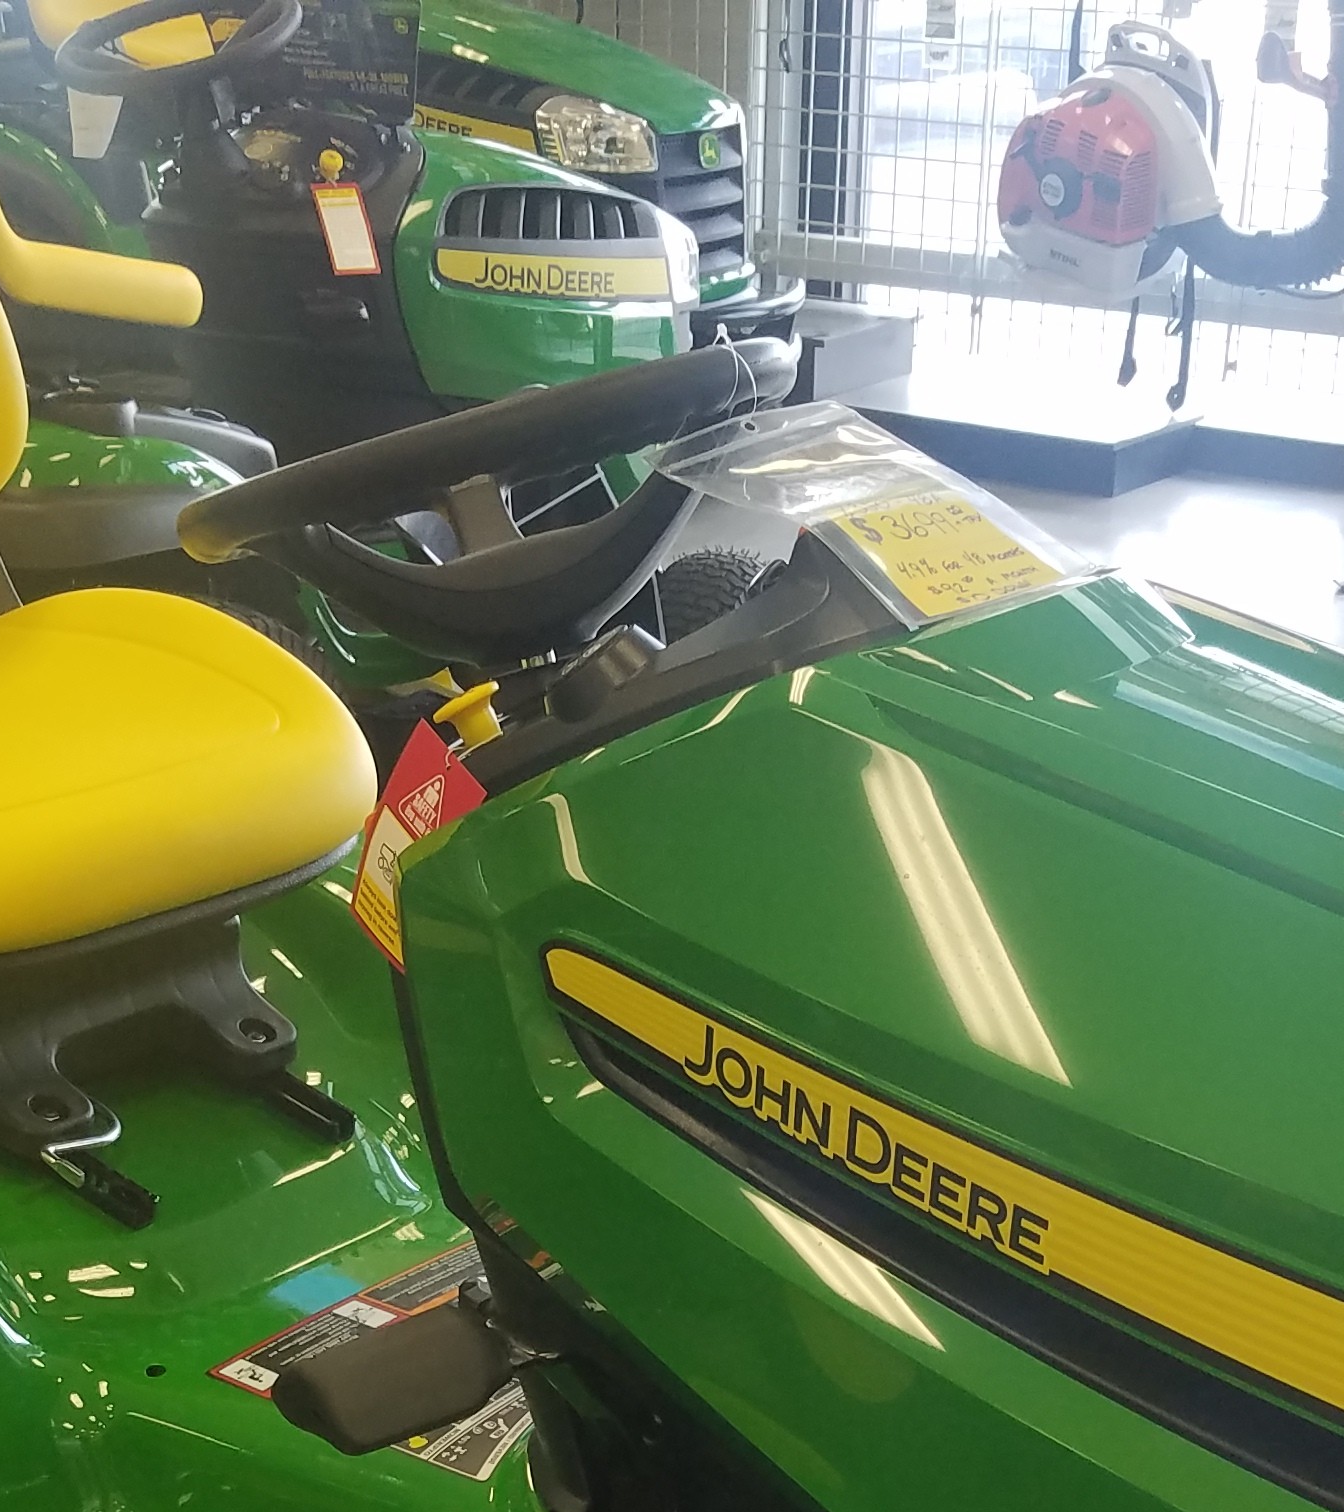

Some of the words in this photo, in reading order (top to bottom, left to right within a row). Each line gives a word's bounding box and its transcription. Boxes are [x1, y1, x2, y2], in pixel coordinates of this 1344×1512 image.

[475, 257, 542, 289] JOHN
[548, 264, 615, 293] DEERE
[684, 1024, 832, 1149] JOHN
[846, 1105, 1050, 1266] DEERE
